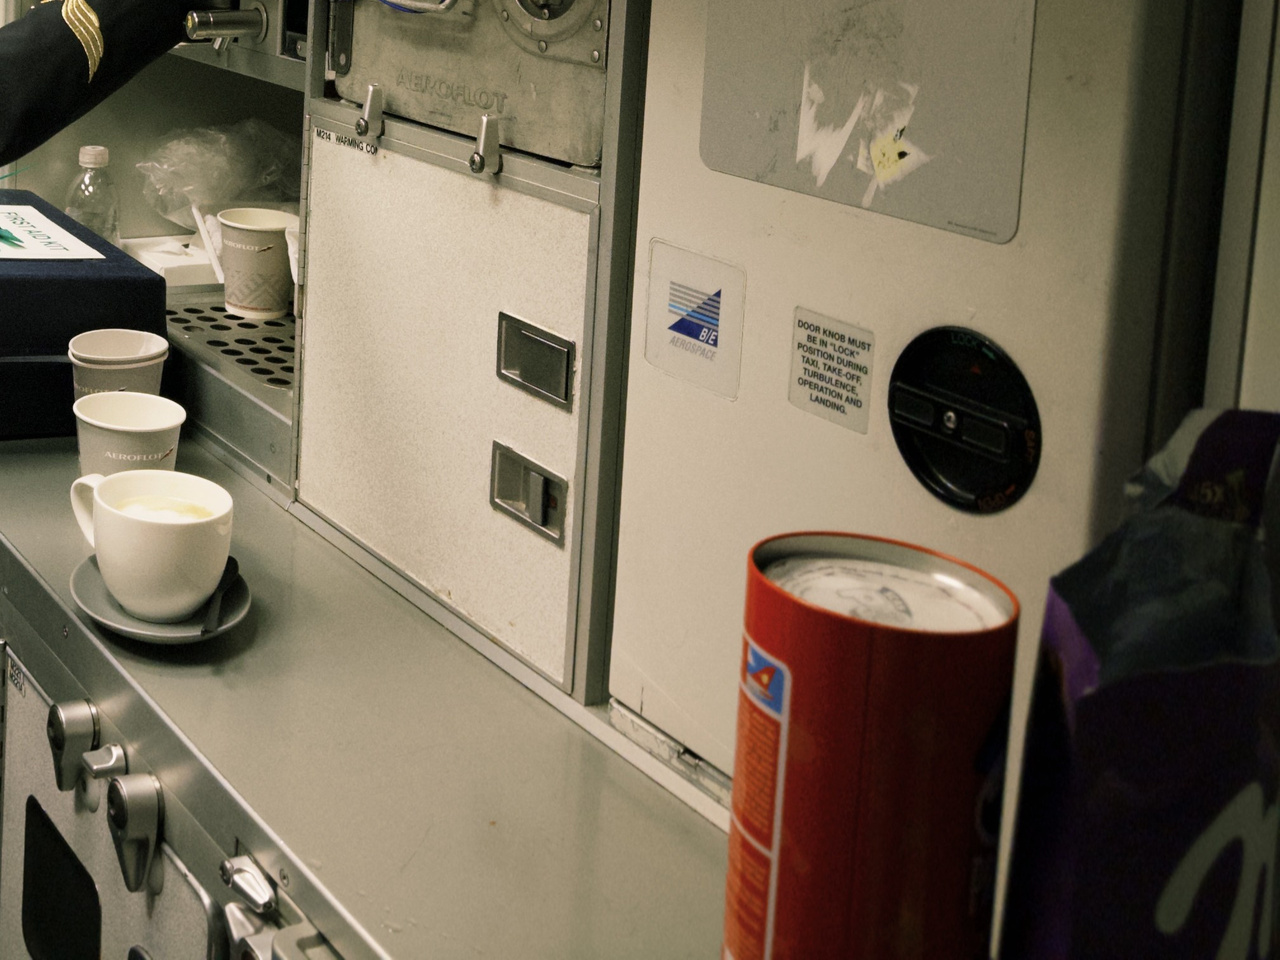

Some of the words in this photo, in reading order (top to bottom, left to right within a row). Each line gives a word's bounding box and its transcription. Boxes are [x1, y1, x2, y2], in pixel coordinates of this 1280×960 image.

[316, 129, 331, 141] M214
[336, 134, 364, 151] WARMING
[0, 211, 37, 229] FIRST
[23, 229, 51, 240] AID
[40, 240, 69, 252] KIT
[668, 335, 717, 361] AEROSPACE
[699, 327, 718, 345] B/E
[797, 319, 821, 335] DOOR
[822, 328, 846, 343] KNOB
[847, 336, 872, 352] MUST
[806, 334, 818, 345] BE
[819, 338, 828, 348] IN
[950, 332, 978, 348] LOCK
[797, 342, 835, 363] POSITION
[836, 356, 869, 376] DURING
[801, 355, 820, 371] TAXI,
[822, 362, 863, 387] TAKE-OFF,
[797, 377, 843, 401] OPERATION
[844, 395, 863, 409] AND
[802, 367, 859, 397] TURBULENCE,
[809, 393, 848, 416] LANDING.
[104, 450, 163, 462] AEROFLOT
